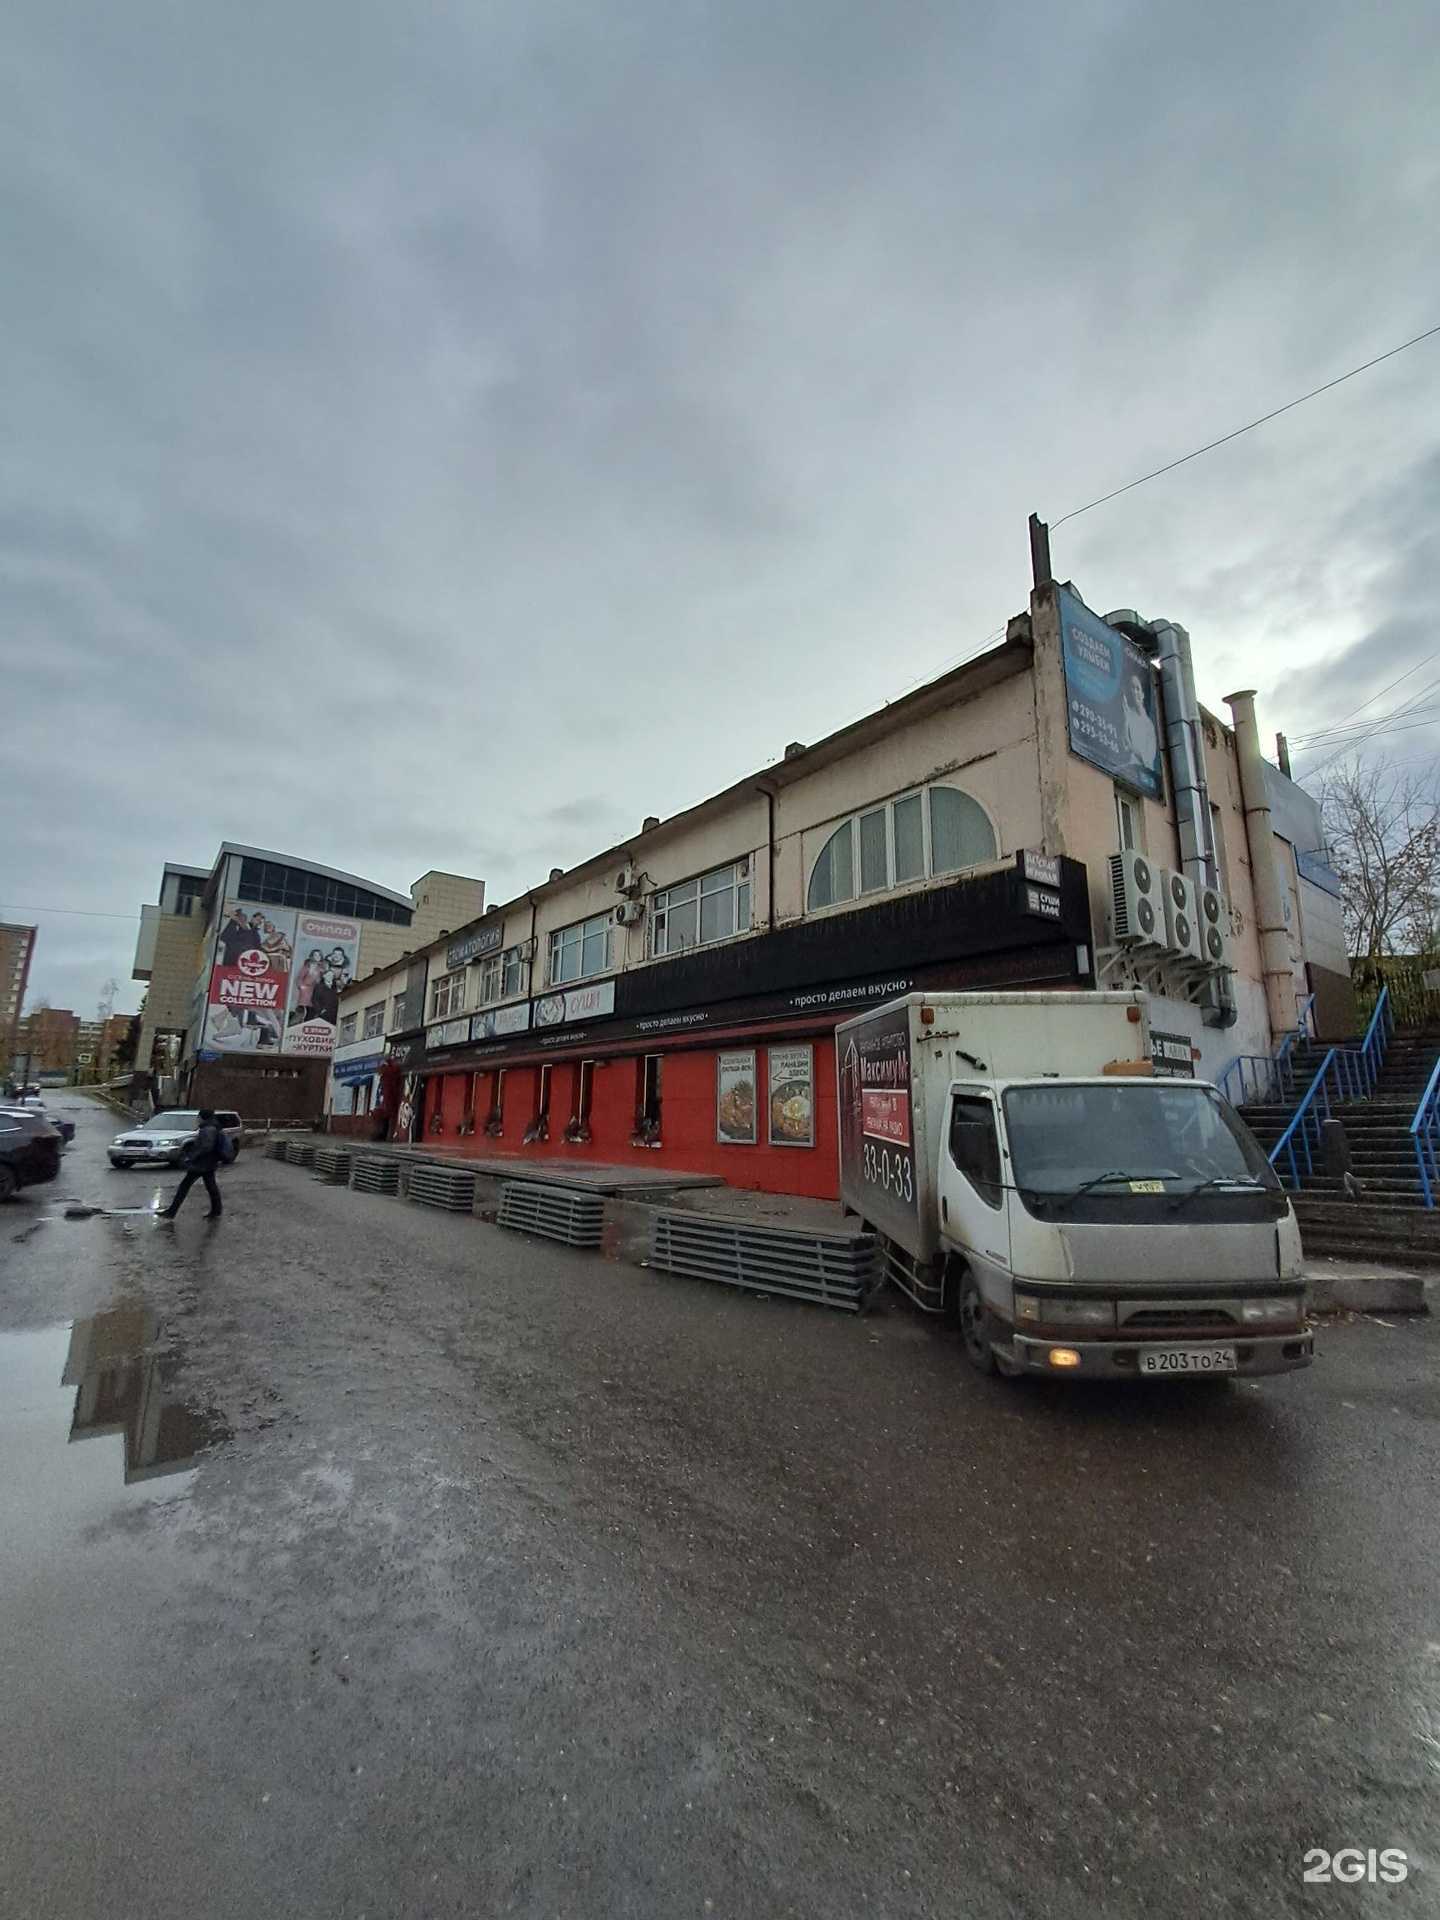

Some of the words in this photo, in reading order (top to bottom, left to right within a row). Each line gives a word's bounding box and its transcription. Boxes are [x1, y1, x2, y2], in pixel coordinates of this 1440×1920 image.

[219, 979, 280, 1000] NEW
[794, 993, 827, 1008] просто
[828, 987, 866, 1002] делаем
[867, 980, 907, 995] вкусно
[219, 995, 277, 1008] COLLECTION
[682, 1013, 705, 1025] вкусно
[863, 1143, 912, 1202] 33-0-33
